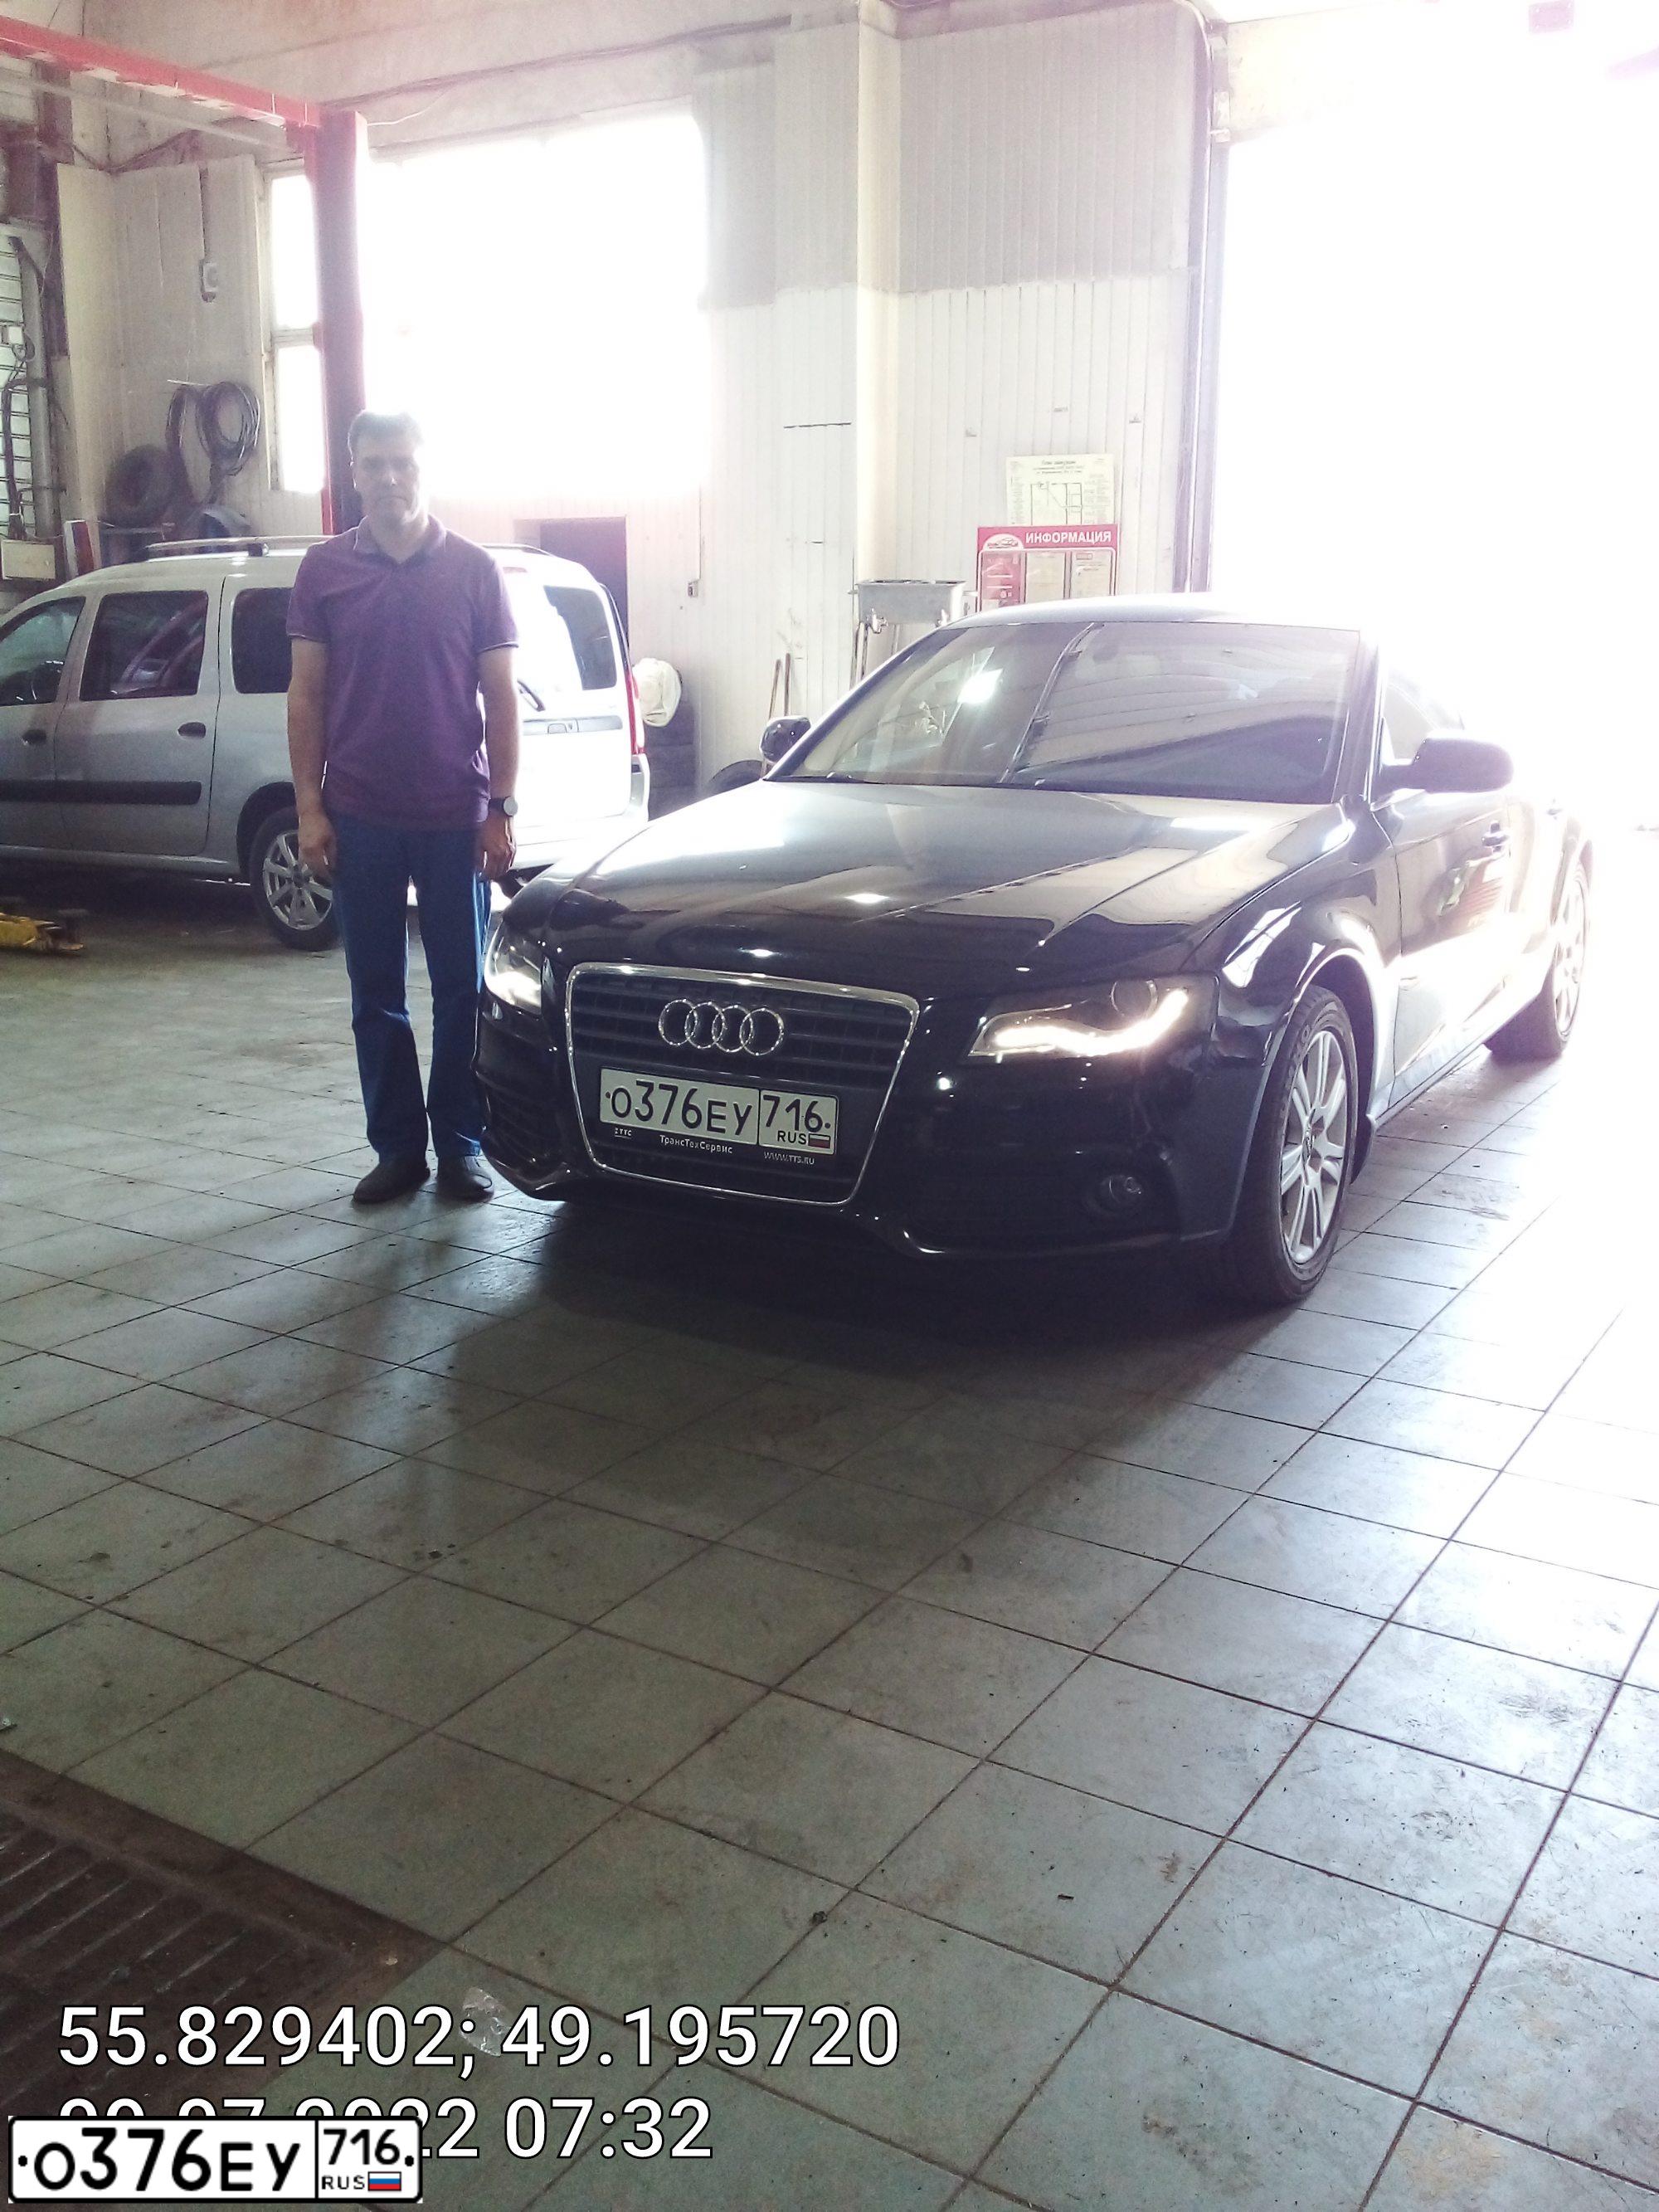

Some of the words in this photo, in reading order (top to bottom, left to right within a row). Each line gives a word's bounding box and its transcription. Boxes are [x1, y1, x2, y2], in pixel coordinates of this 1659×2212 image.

[1025, 531, 1112, 544] ИНФОРМАЦИЯ
[762, 1094, 824, 1133] 716
[659, 1134, 733, 1154] ТрансТехСервис
[777, 1130, 807, 1145] RUS
